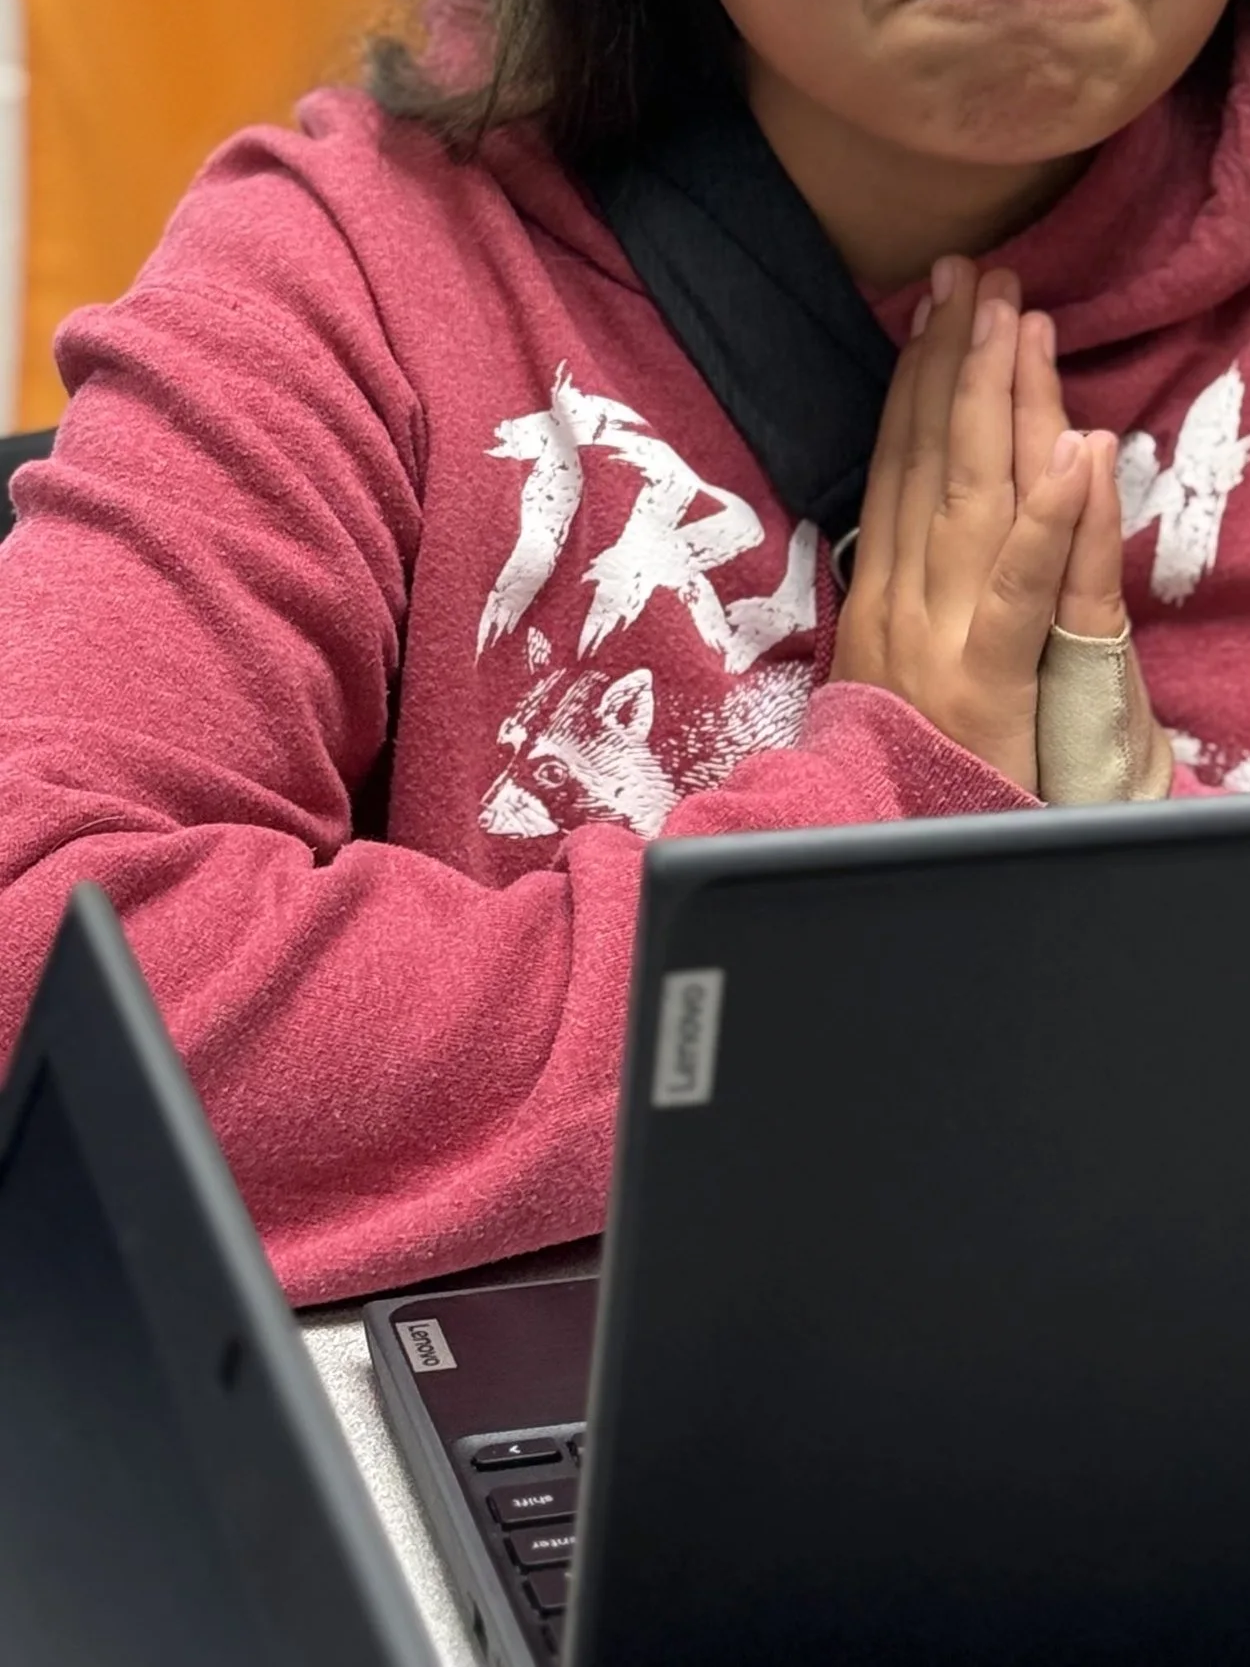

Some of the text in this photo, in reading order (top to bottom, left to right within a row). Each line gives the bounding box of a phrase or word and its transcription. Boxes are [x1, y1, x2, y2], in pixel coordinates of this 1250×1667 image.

[664, 983, 705, 1094] Lenovo
[408, 1323, 441, 1367] Lenovo
[512, 1494, 554, 1508] shift
